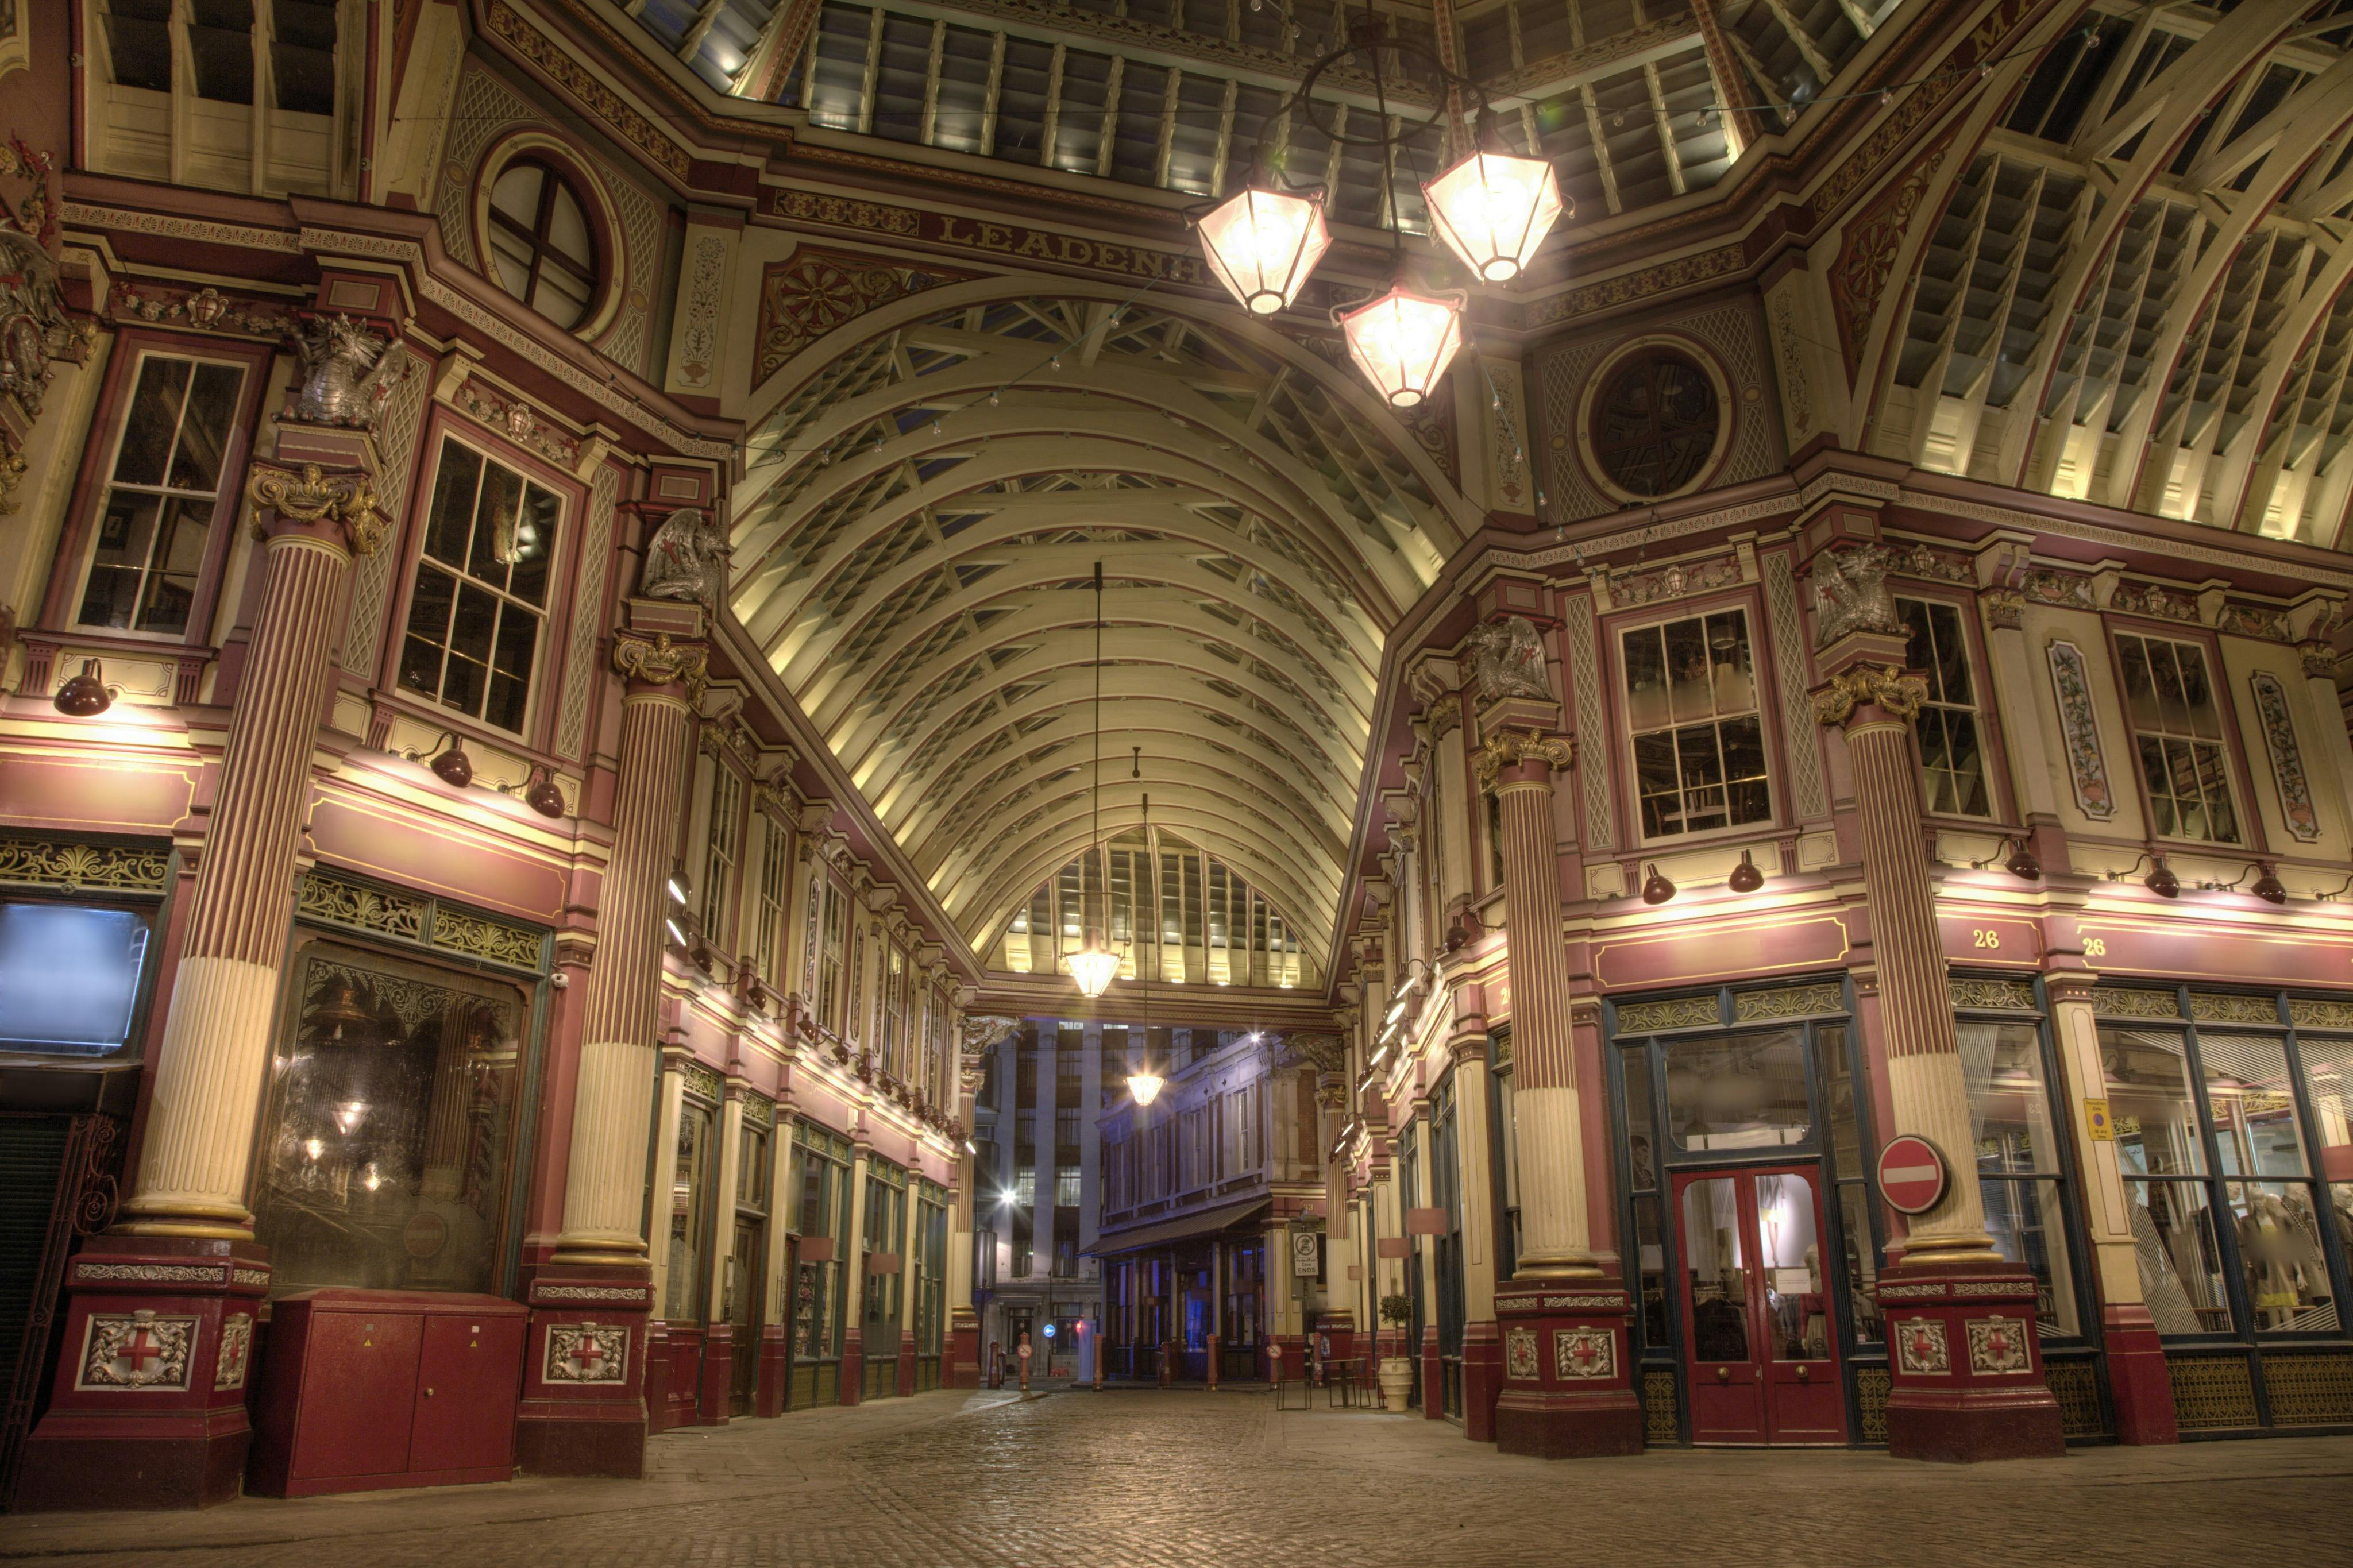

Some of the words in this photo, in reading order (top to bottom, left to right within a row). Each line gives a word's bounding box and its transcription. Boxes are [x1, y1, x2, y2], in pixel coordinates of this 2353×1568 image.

[939, 216, 1316, 304] LEADENH
[1973, 929, 2000, 948] 26
[2082, 937, 2105, 956] 26
